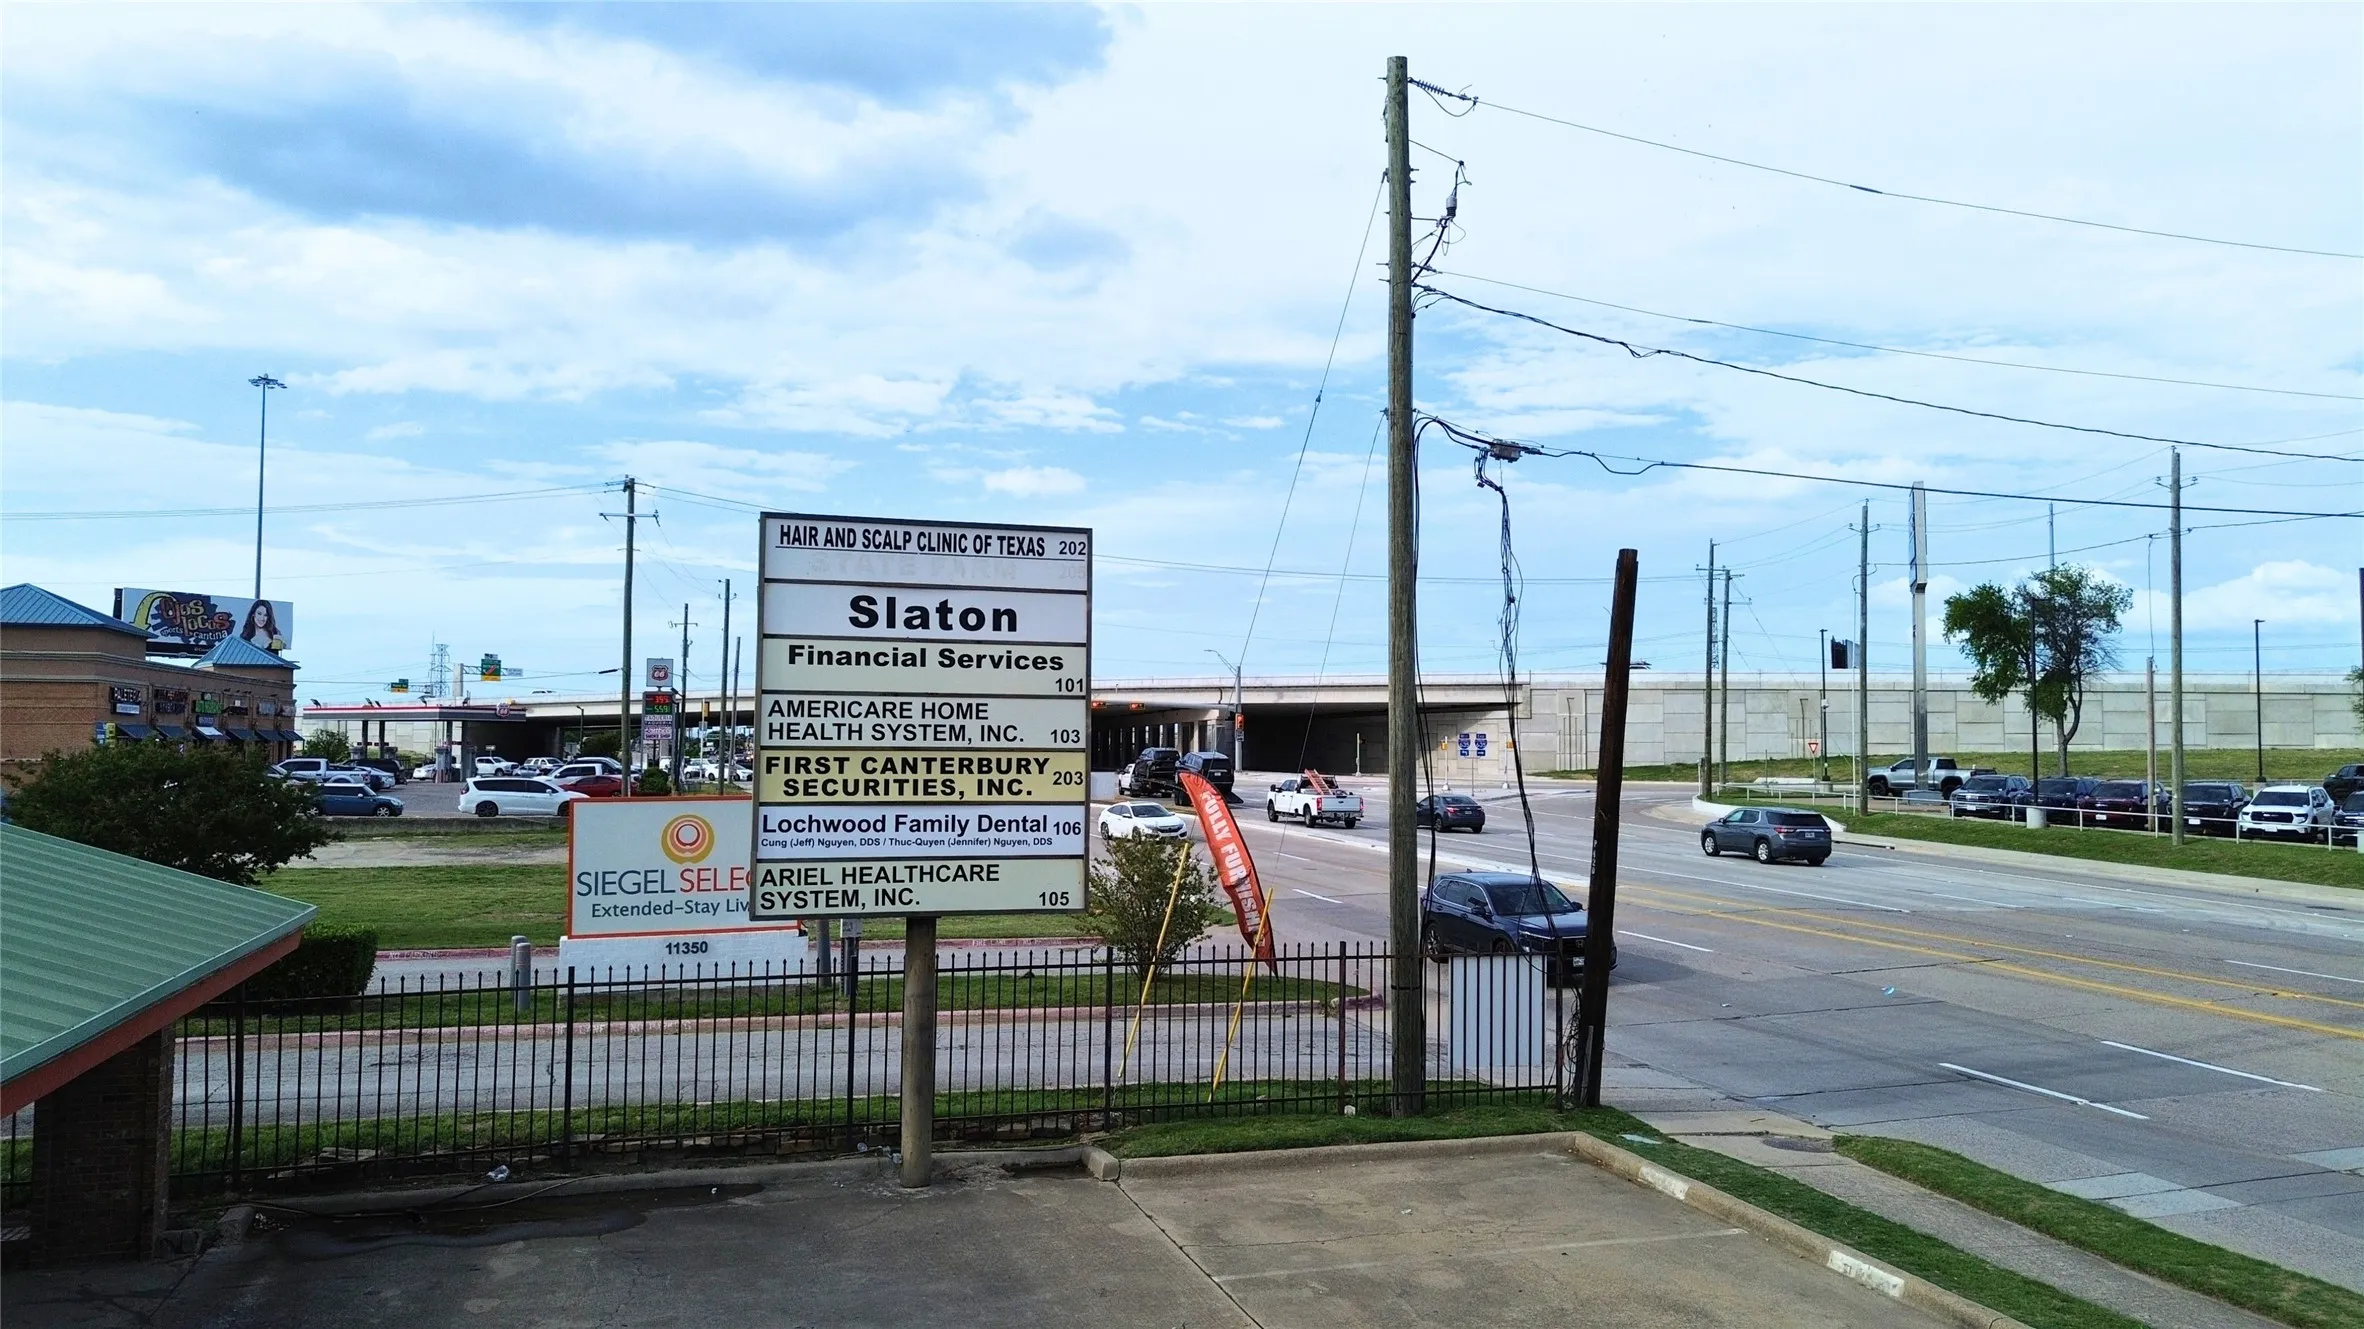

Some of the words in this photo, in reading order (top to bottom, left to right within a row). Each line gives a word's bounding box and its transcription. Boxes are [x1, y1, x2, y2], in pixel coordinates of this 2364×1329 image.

[779, 524, 819, 546] HAIR
[823, 526, 857, 548] AND
[862, 528, 912, 550] SCALP
[917, 531, 968, 553] CLINIC
[972, 534, 993, 555] OF
[997, 535, 1046, 557] TEXAS
[1059, 540, 1087, 556] 202
[848, 594, 1017, 633] Slaton
[788, 644, 927, 668] Financial
[938, 647, 1064, 671] Services
[1055, 677, 1084, 693] 101
[767, 700, 913, 719] AMERICARE
[921, 702, 989, 720] HOME
[768, 722, 863, 741] HEALTH
[871, 723, 972, 745] SYSTEM,
[980, 724, 1024, 742] INC.
[1050, 729, 1081, 744] 103
[765, 756, 850, 775] FIRST
[861, 756, 1050, 775] CANTERBURY
[783, 778, 965, 800] SECURITIES,
[977, 778, 1033, 796] INC.
[1052, 771, 1084, 786] 203
[762, 814, 886, 834] Lochwood
[894, 814, 970, 837] Family
[977, 814, 1048, 833] Dental
[1053, 821, 1082, 836] 106
[1202, 790, 1233, 841] FULLY
[761, 838, 787, 848] Cung
[790, 838, 815, 848] (Jeff)
[818, 838, 857, 848] Nguyen,
[860, 838, 881, 846] DDS
[889, 838, 945, 848] Thuc-Quyen
[947, 838, 991, 848] (Jennifer)
[993, 838, 1031, 848] Nguyen,
[1033, 838, 1053, 846] DDS
[576, 869, 676, 897] SIEGEL
[680, 866, 752, 893] SELE
[760, 867, 833, 887] ARIEL
[842, 864, 1000, 885] HEALTHCARE
[591, 899, 721, 918] Extended-Stay
[726, 898, 750, 913] Liv
[760, 889, 866, 911] SYSTEM,
[874, 888, 920, 907] INC.
[1038, 892, 1070, 906] 105
[665, 941, 709, 955] 11350
